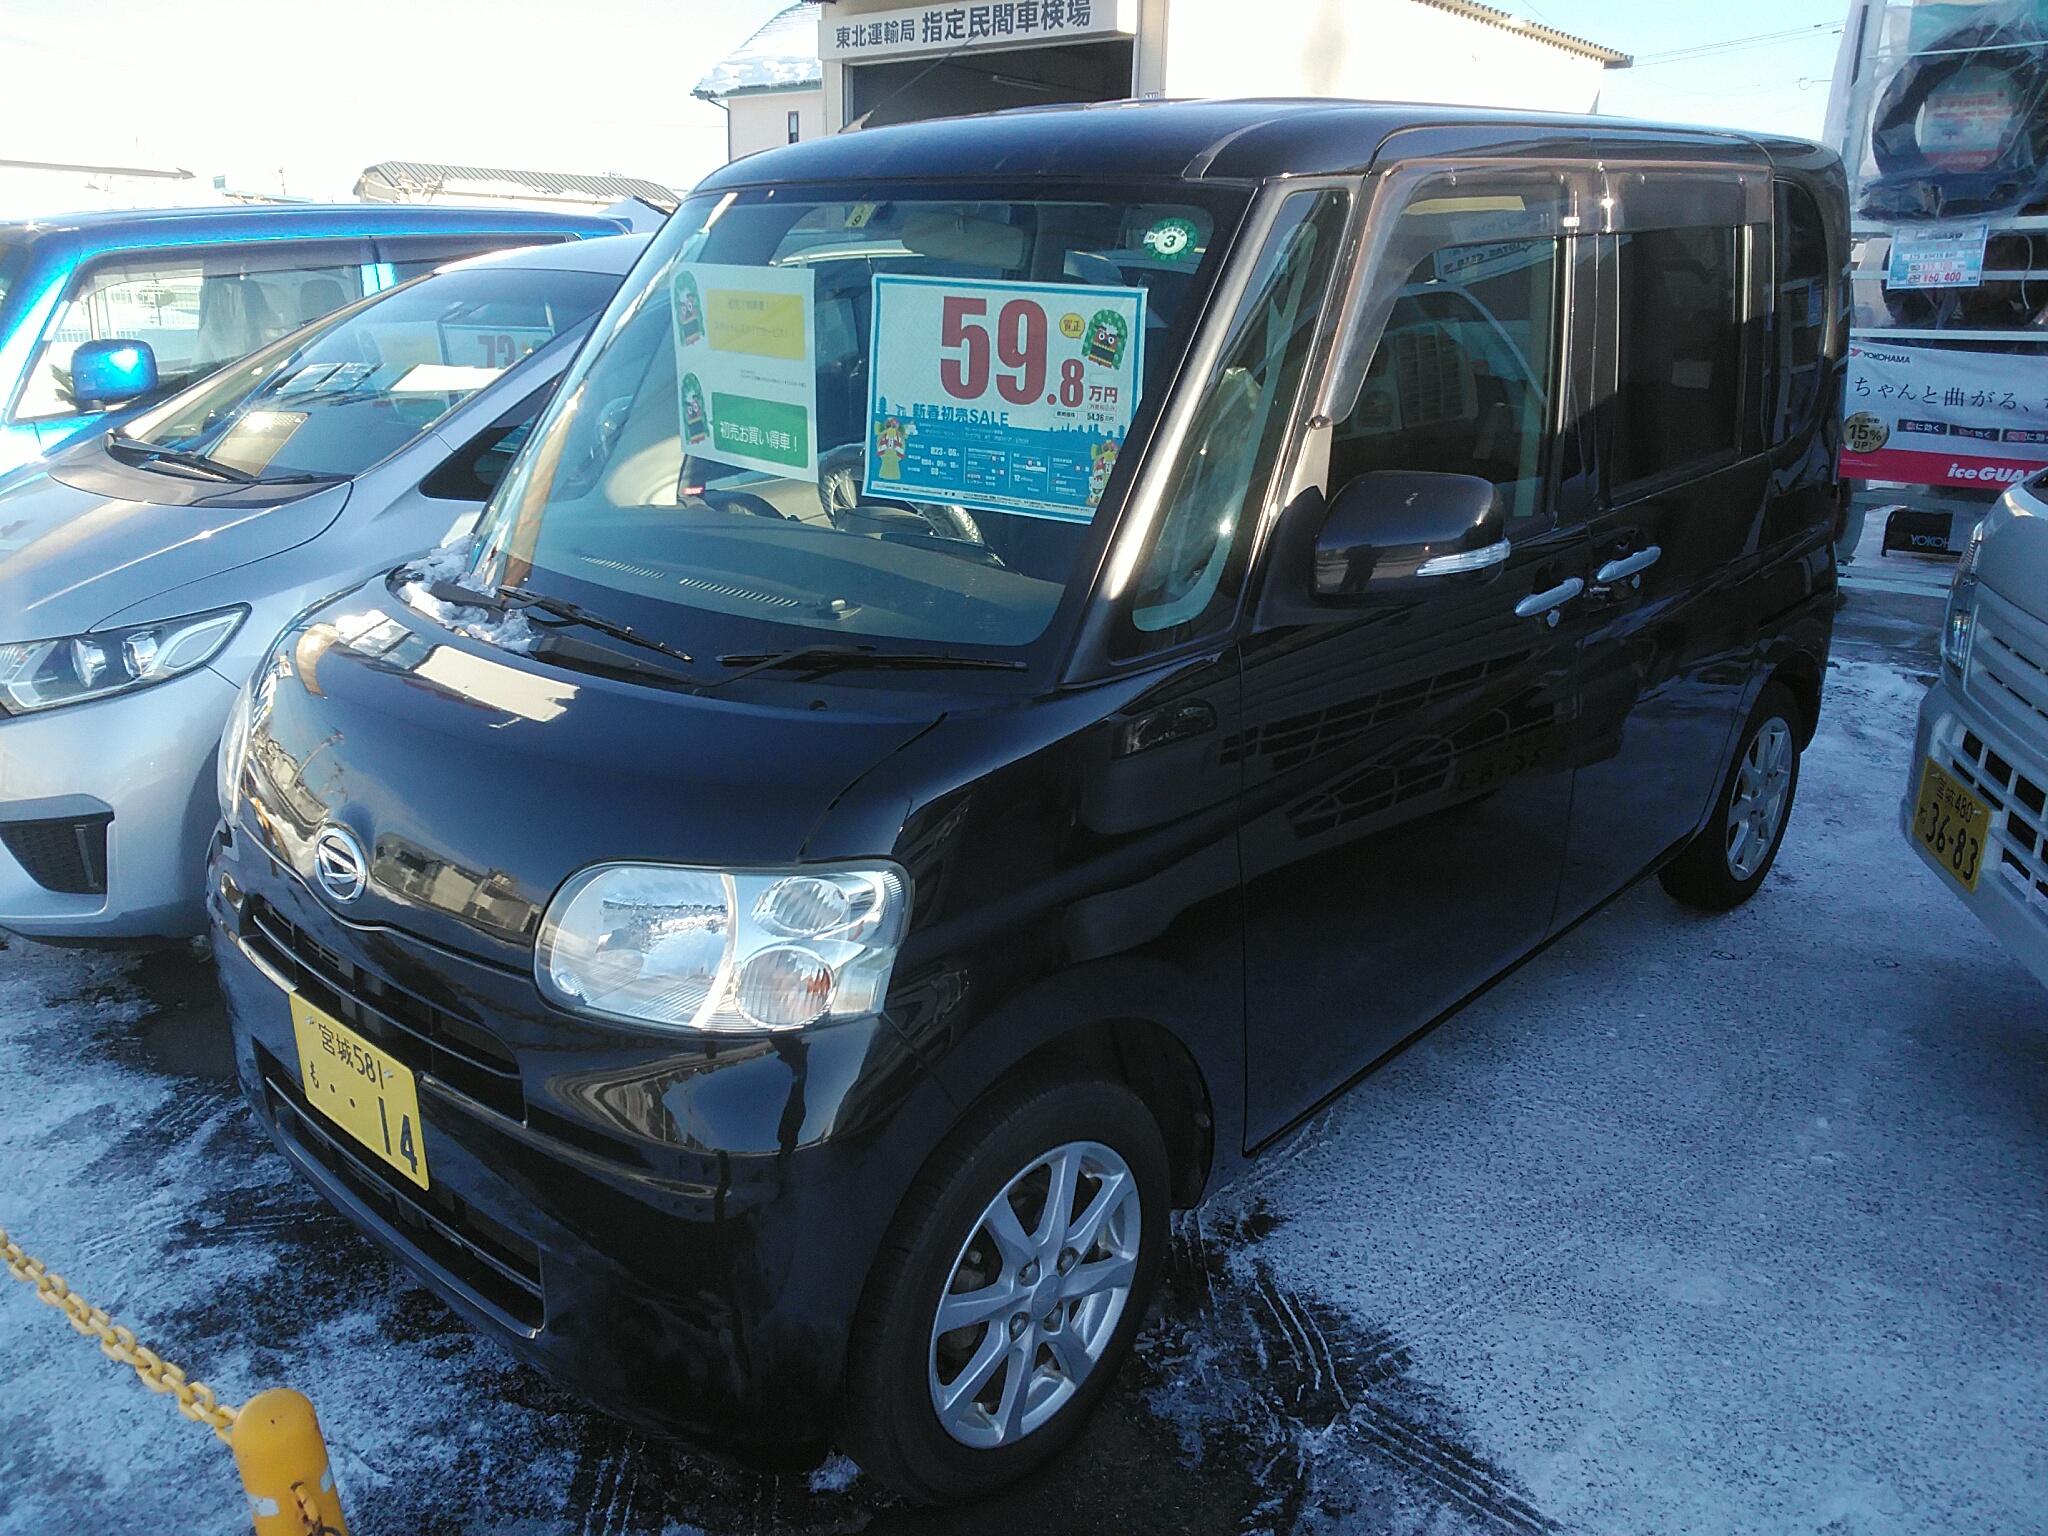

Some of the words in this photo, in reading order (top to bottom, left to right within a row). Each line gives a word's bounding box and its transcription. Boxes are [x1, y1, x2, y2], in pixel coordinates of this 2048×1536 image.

[835, 19, 916, 49] 東北運輸局
[922, 0, 1091, 43] 指定民間車検場
[1163, 234, 1177, 248] 3
[940, 296, 1084, 408] 59.8
[1863, 351, 1911, 364] YOKOHAMA
[1088, 386, 1118, 404] 万円
[1855, 376, 2048, 412] ちゃんと曲がる、
[310, 1060, 320, 1089] も
